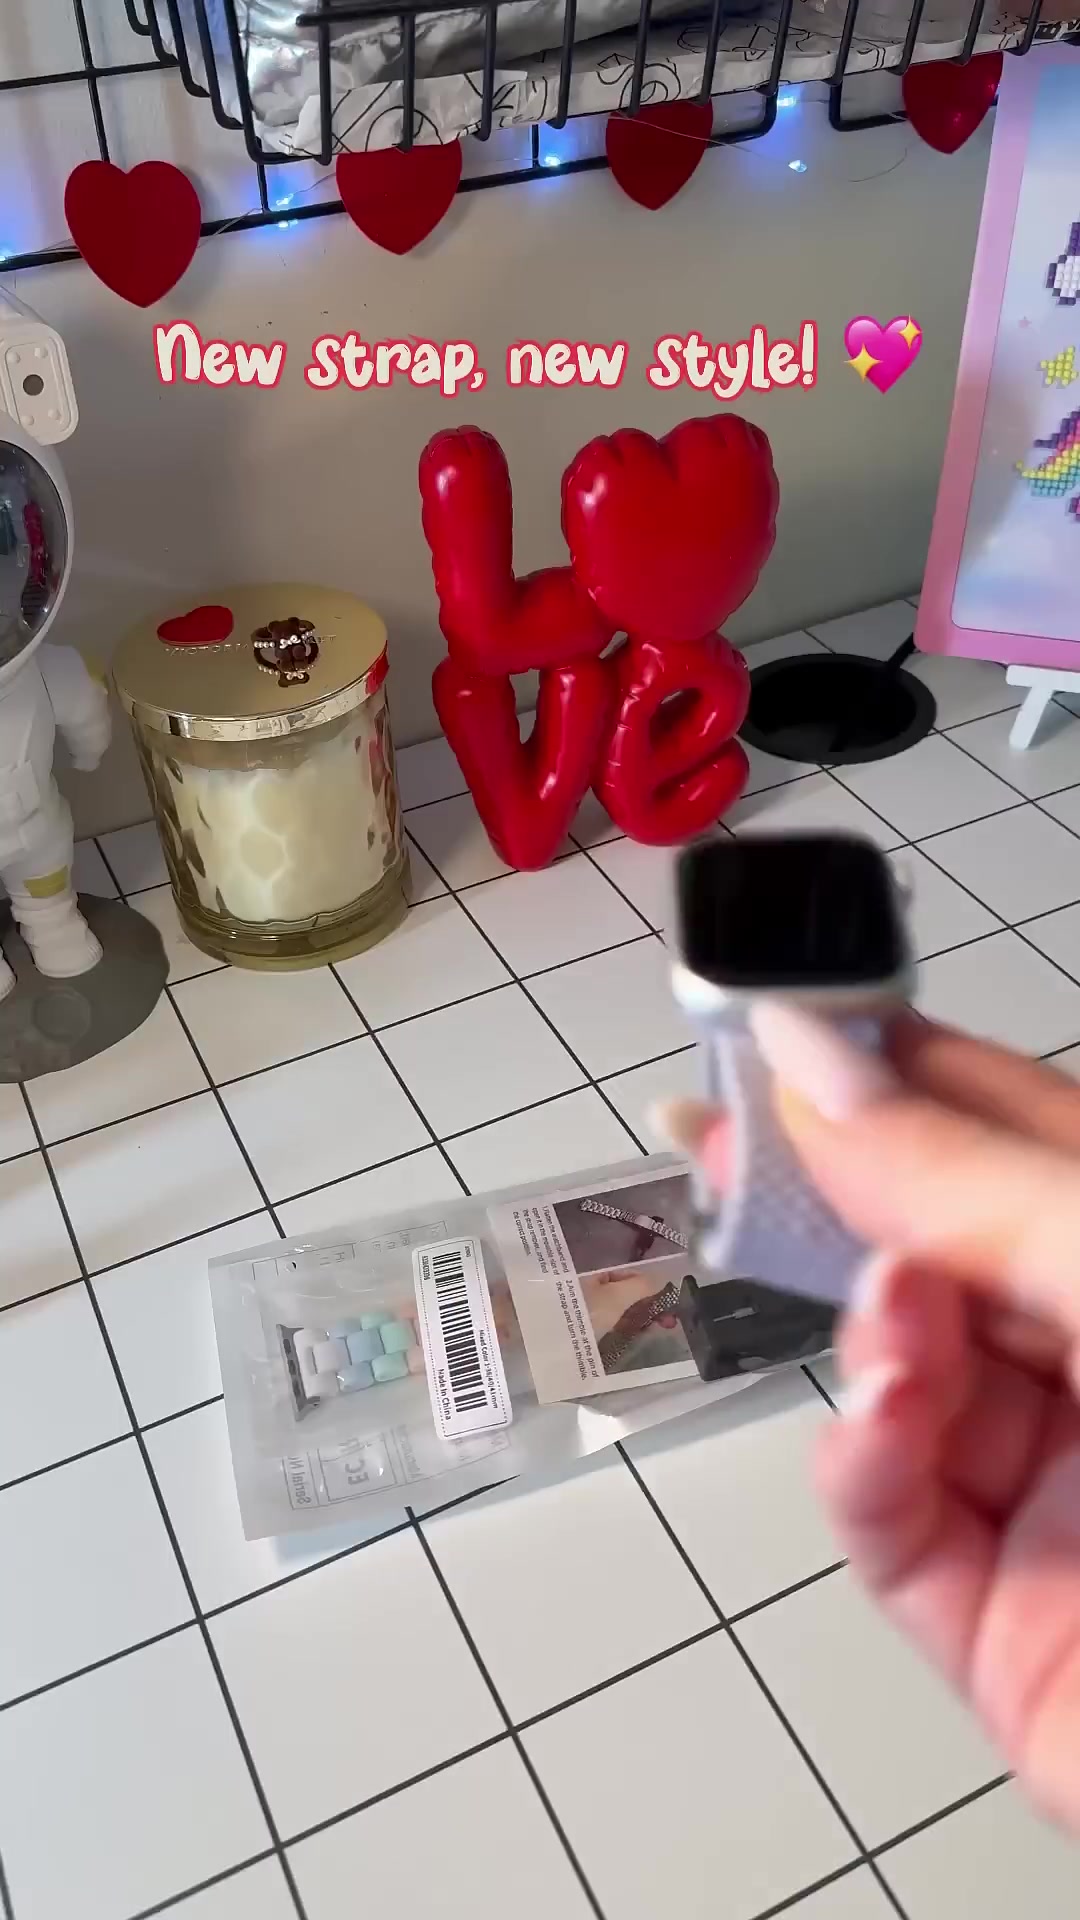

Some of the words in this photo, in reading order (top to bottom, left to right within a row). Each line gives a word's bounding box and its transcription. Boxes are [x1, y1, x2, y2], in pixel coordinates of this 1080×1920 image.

[481, 1346, 489, 1362] Color
[438, 1368, 447, 1388] Made
[442, 1397, 451, 1420] China
